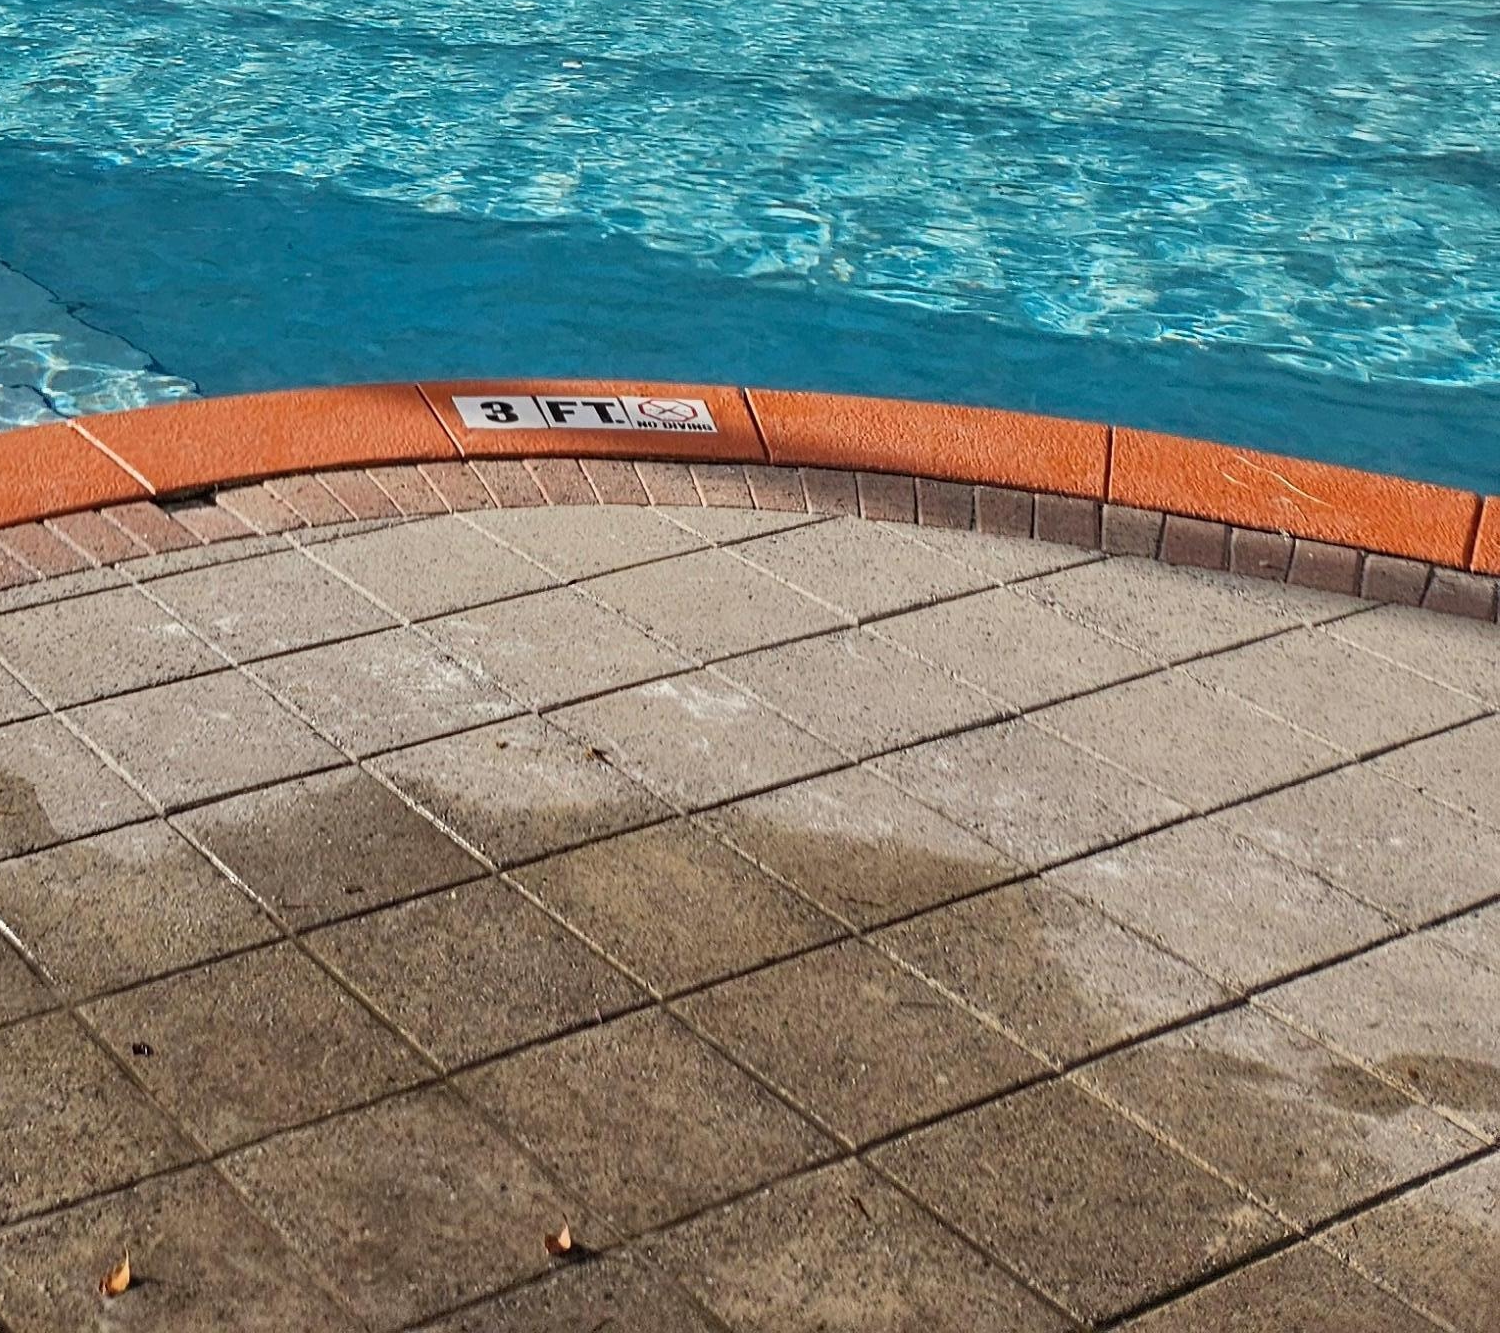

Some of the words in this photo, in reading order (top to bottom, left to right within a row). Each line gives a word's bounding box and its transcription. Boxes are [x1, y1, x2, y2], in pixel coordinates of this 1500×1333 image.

[479, 400, 520, 424] 3
[636, 420, 658, 428] NO
[662, 421, 713, 431] DIVING
